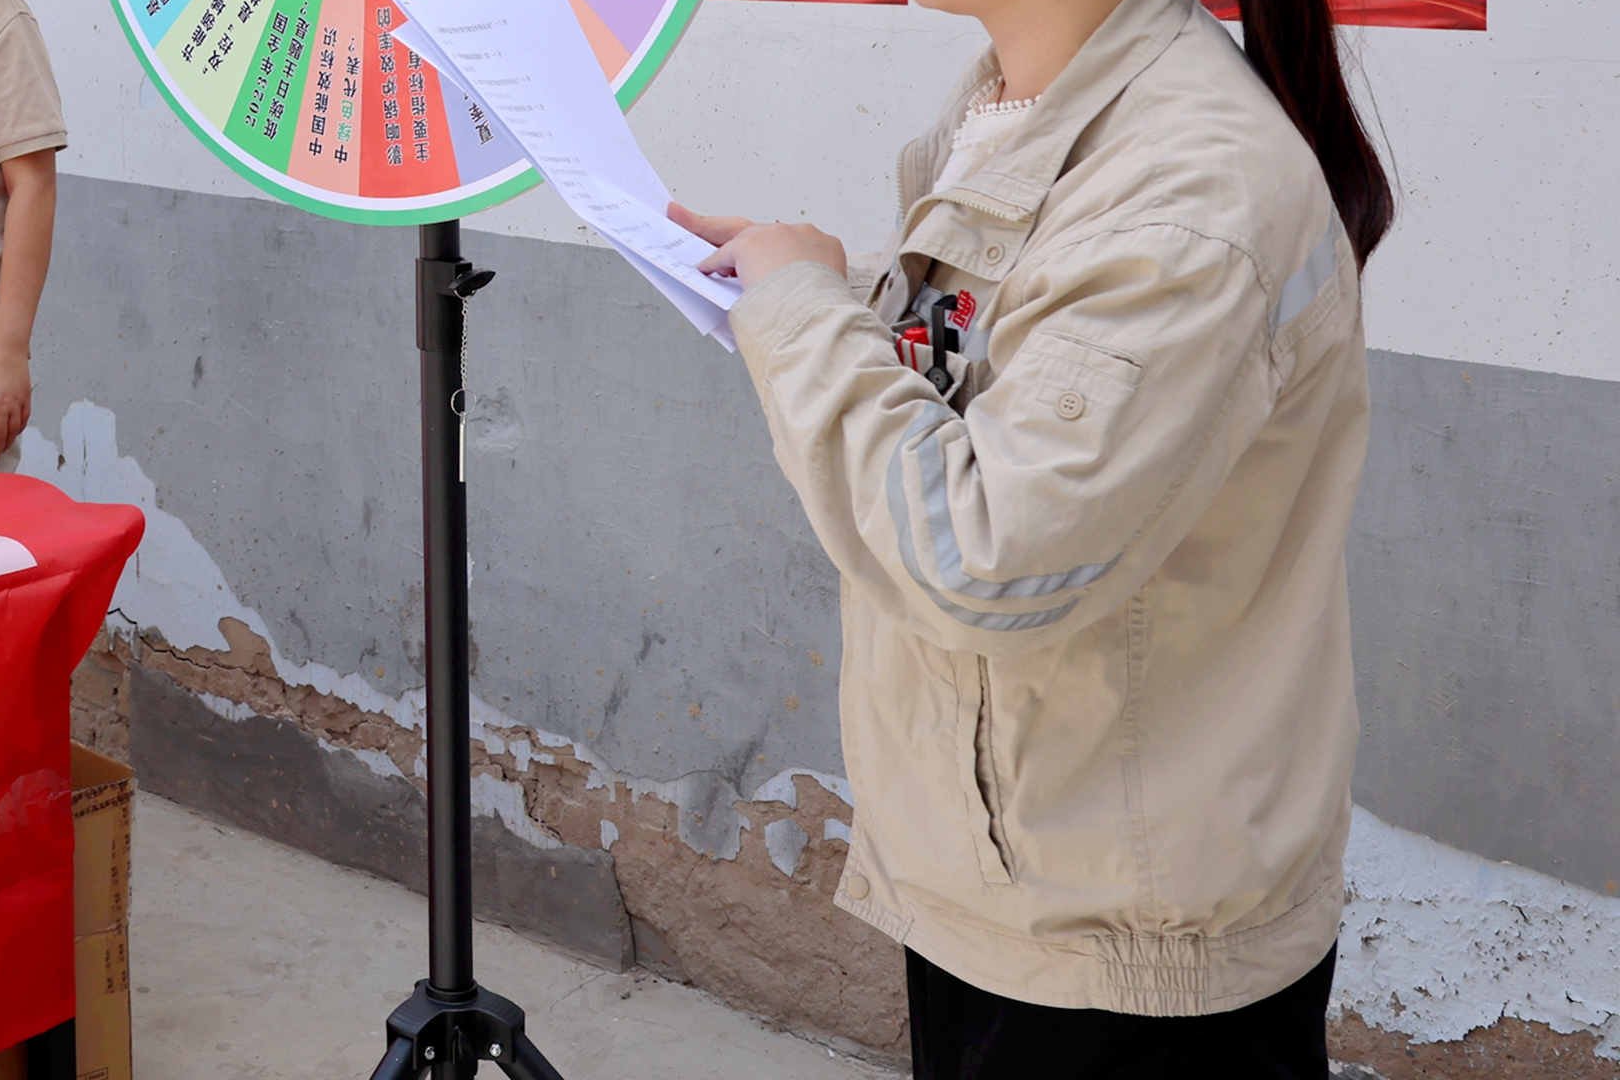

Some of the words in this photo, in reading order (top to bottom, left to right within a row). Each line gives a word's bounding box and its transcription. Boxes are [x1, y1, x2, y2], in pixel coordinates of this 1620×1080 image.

[244, 11, 289, 127] 2023年全国
[263, 1, 311, 140] 低碳日主题是？
[309, 25, 337, 156] 中国能效标识
[334, 36, 361, 163] 中绿色代表？
[376, 6, 403, 165] 影响锅炉效率的
